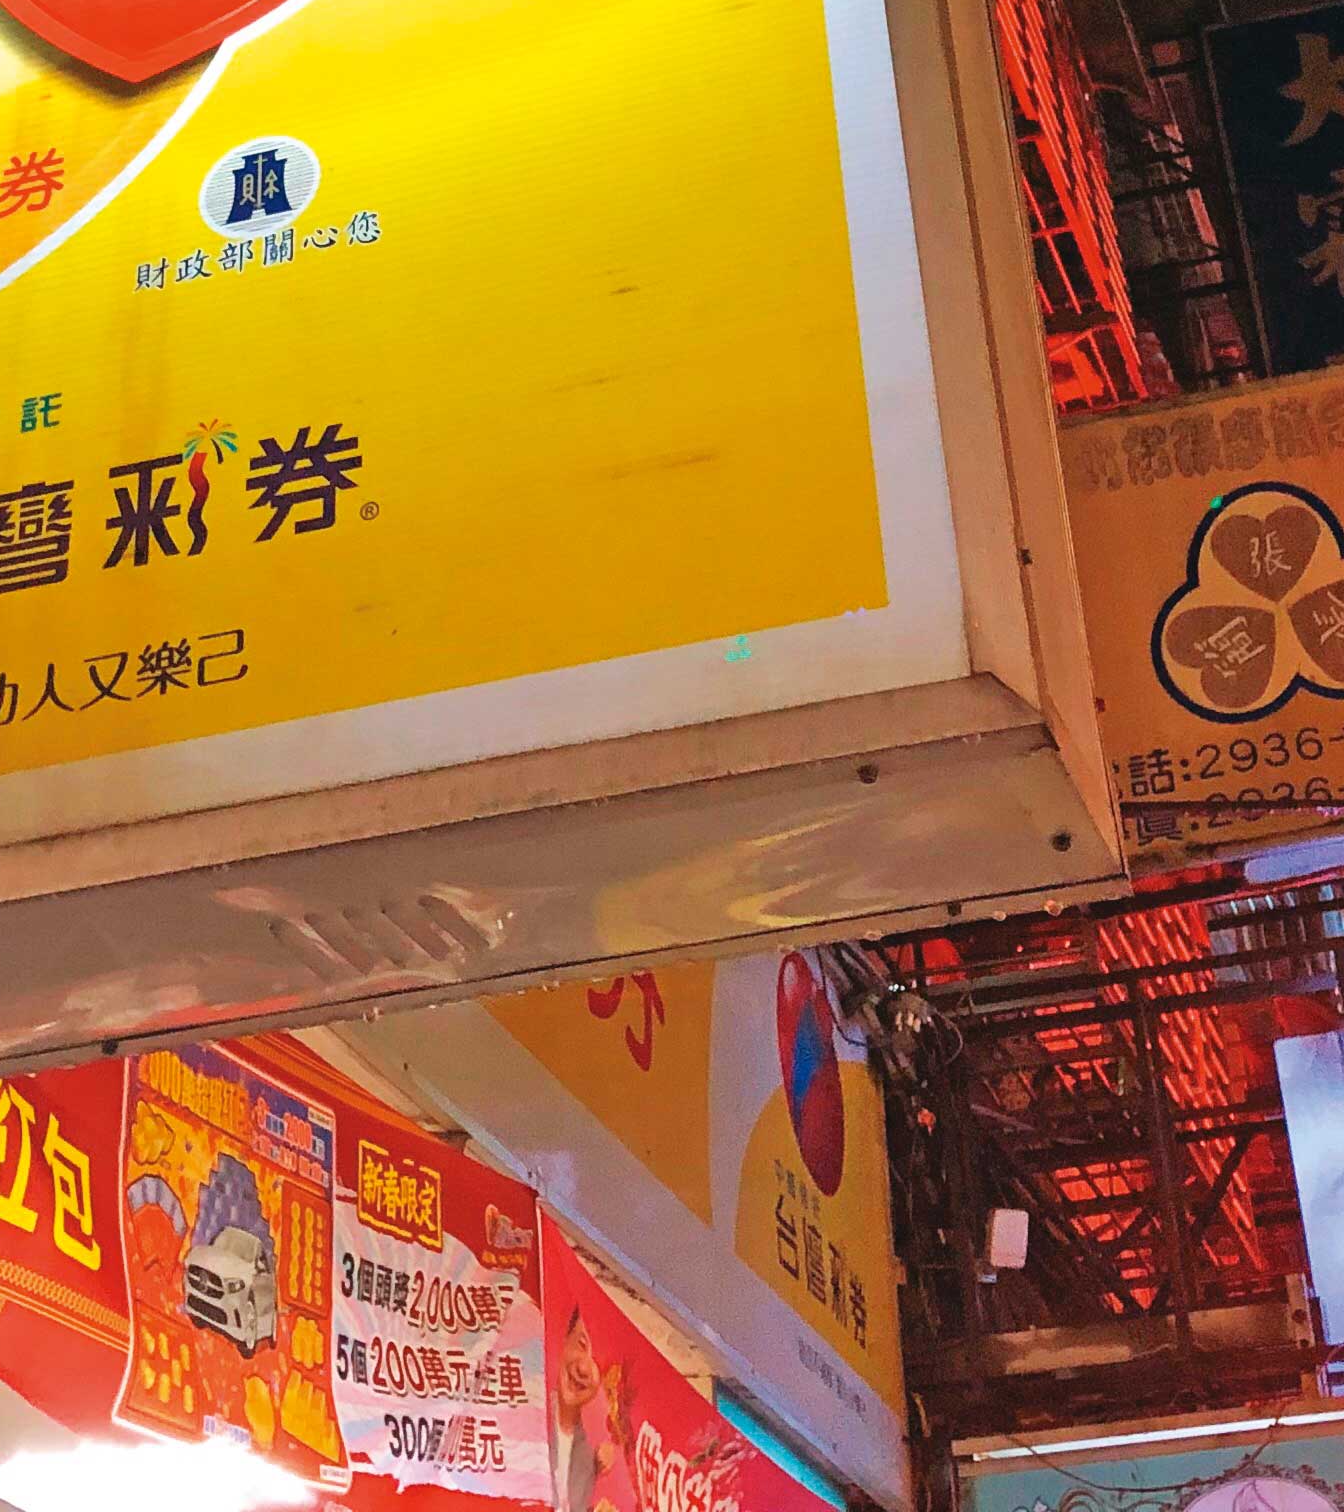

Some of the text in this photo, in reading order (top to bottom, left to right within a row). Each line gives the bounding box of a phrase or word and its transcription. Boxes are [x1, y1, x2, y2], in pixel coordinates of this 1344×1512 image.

[134, 211, 383, 291] 財政部關心您
[1250, 531, 1292, 578] 張
[362, 1156, 438, 1231] 新春限定
